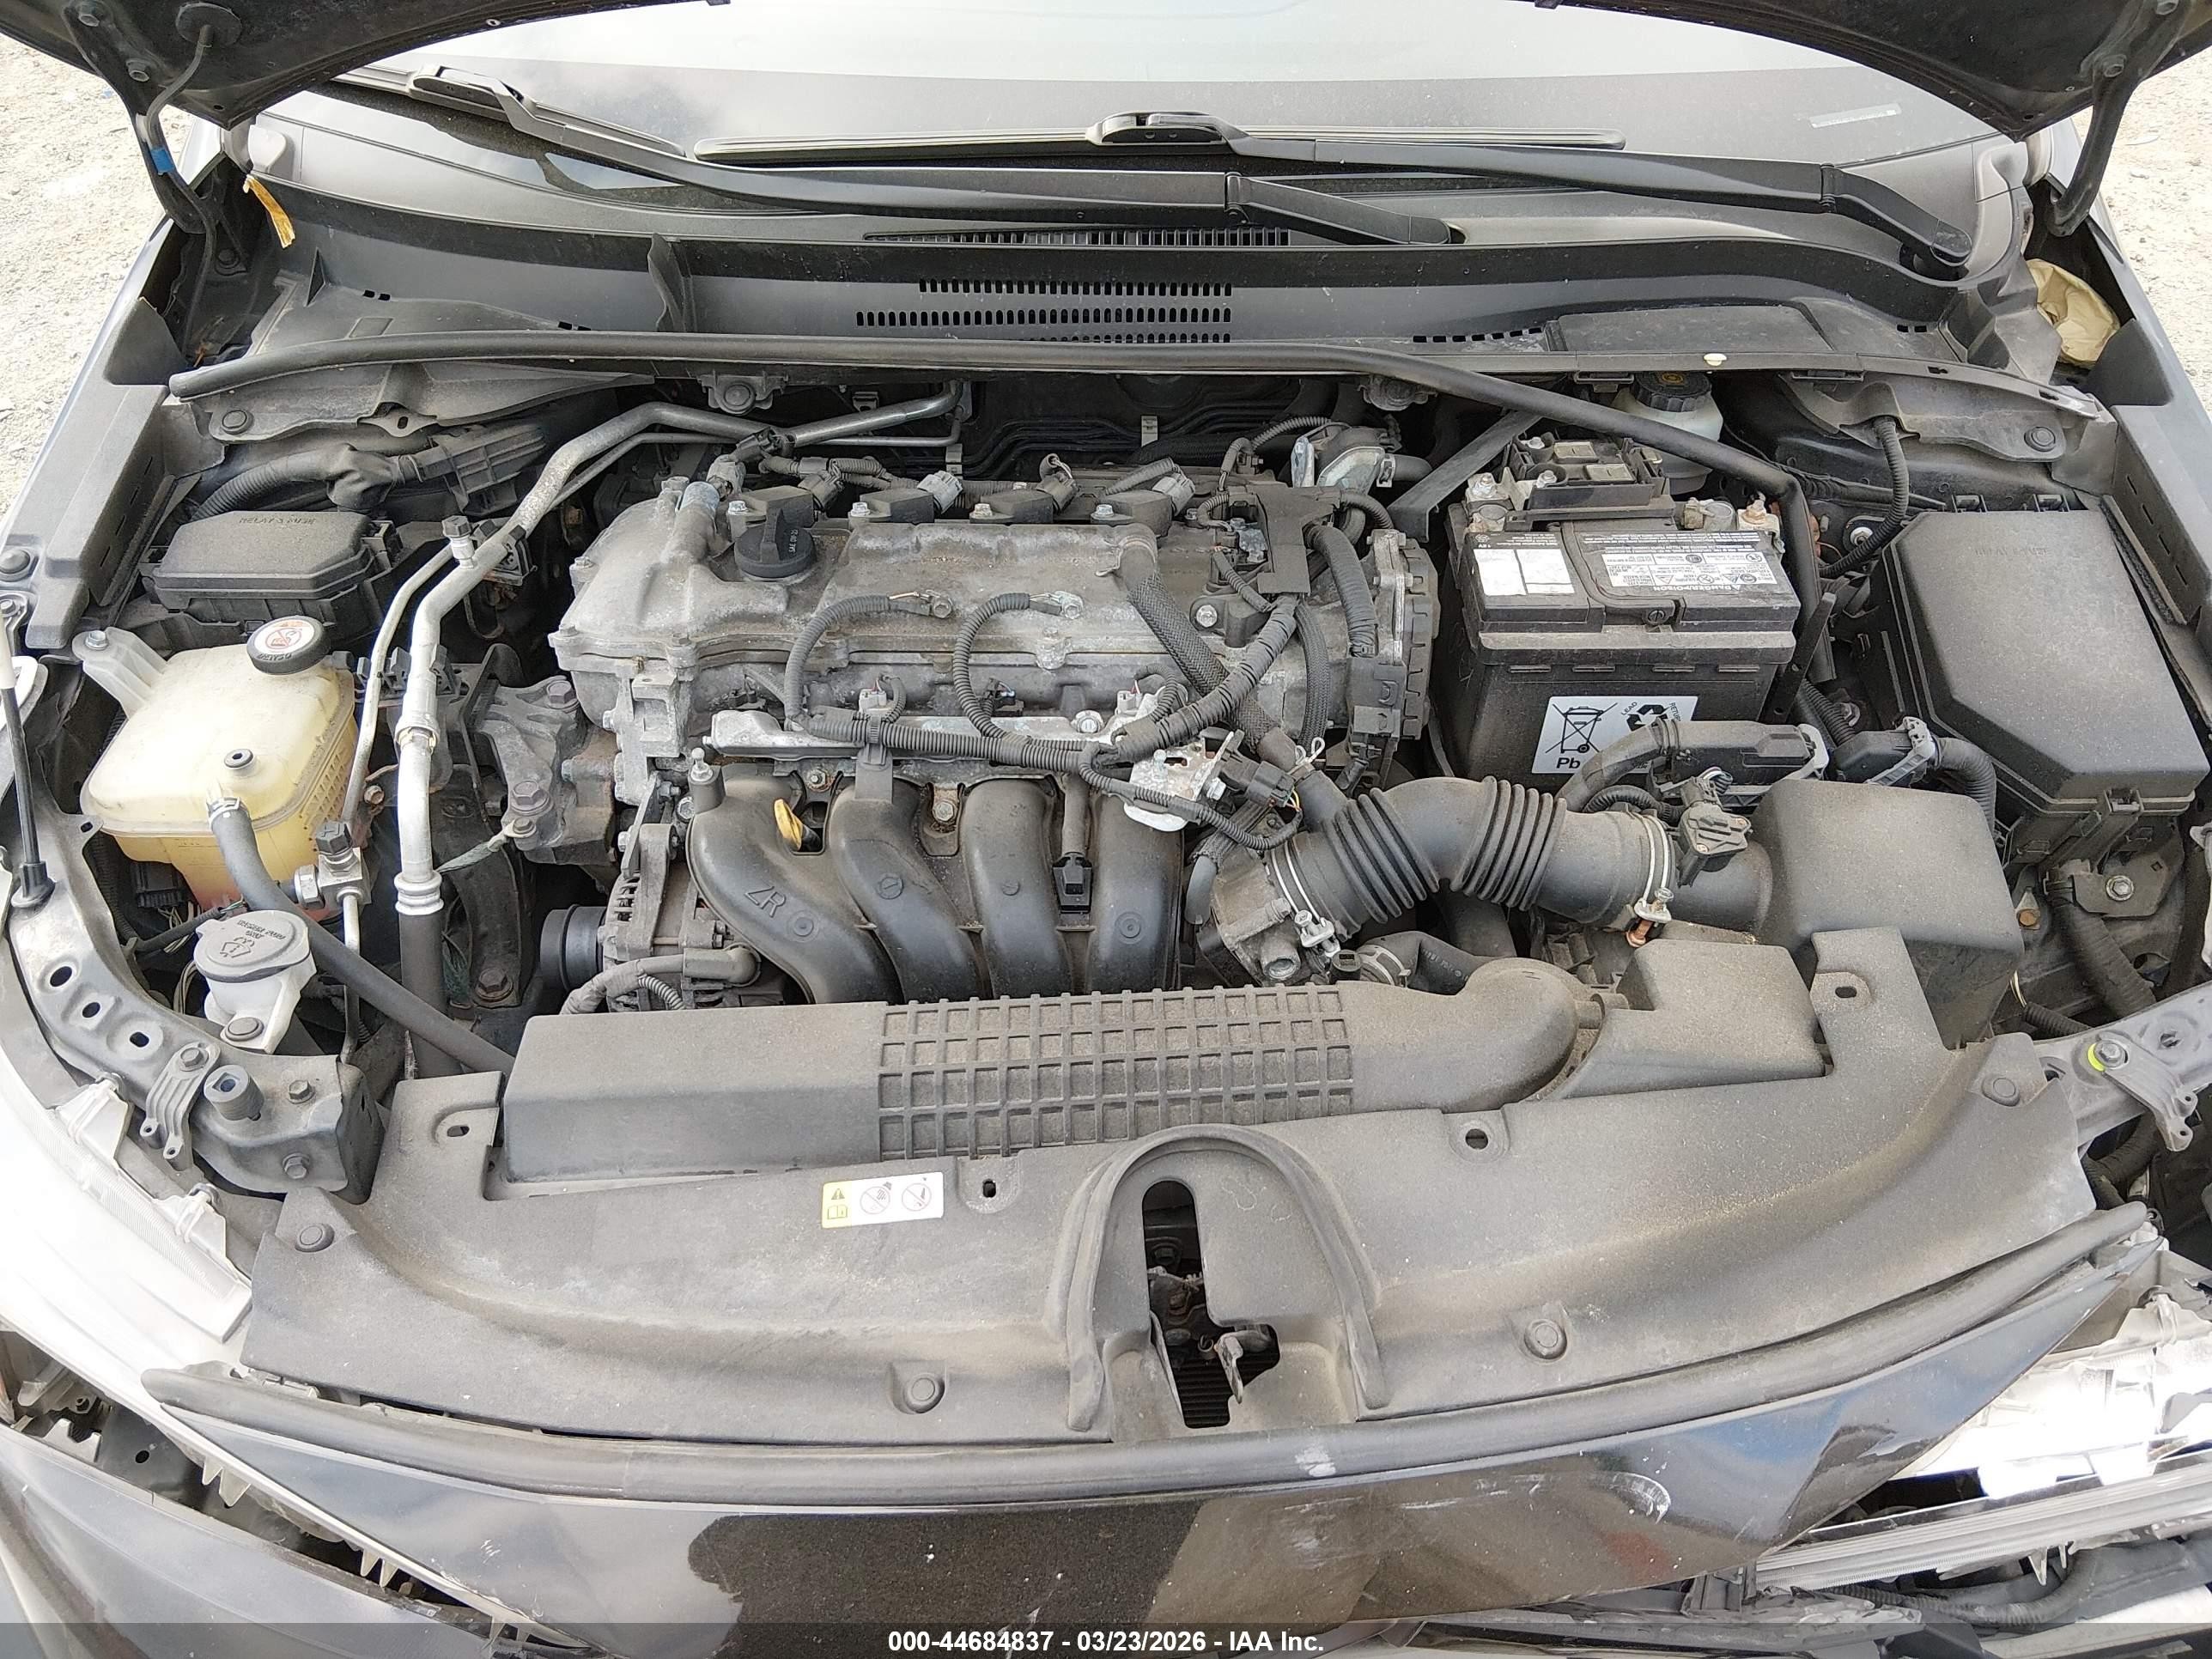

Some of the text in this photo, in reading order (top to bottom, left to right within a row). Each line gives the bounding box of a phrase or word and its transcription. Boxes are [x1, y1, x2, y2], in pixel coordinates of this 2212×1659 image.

[257, 653, 292, 661] DENSO
[1620, 701, 1638, 716] LEAD
[1556, 757, 1581, 769] Pb
[744, 884, 787, 919] ZR
